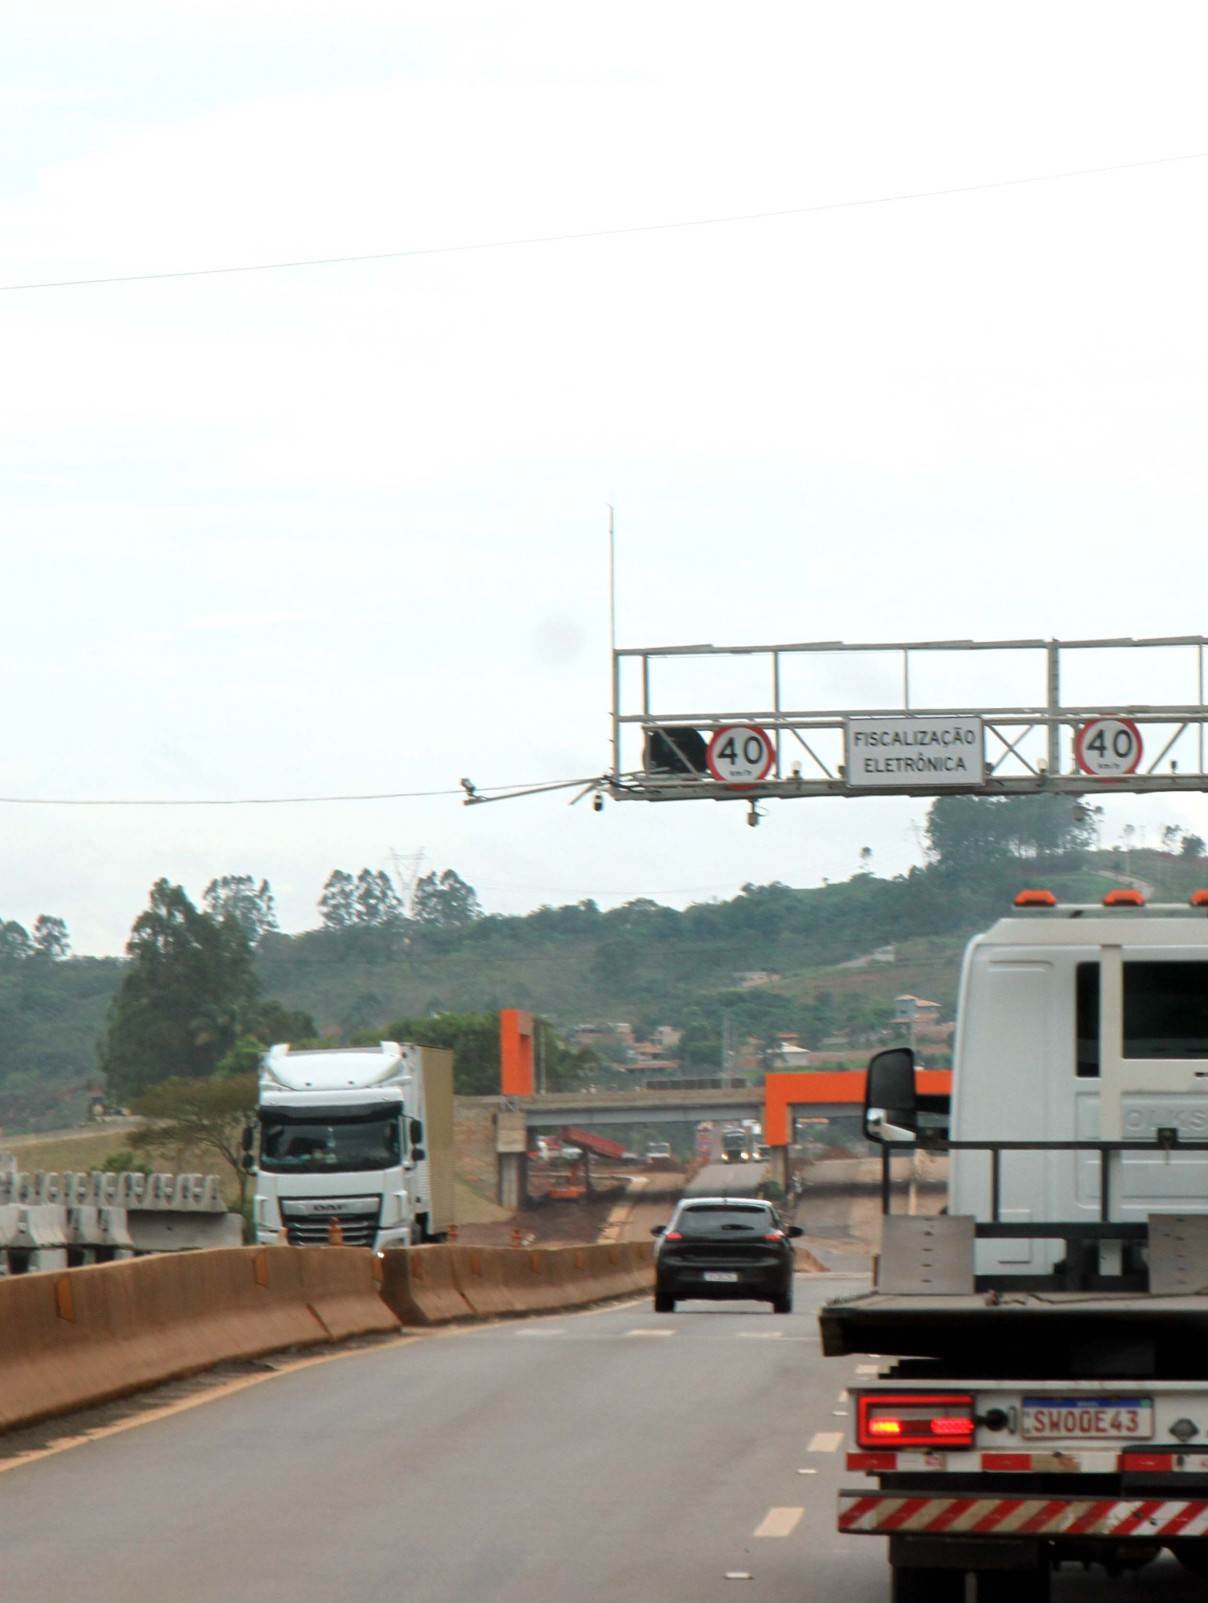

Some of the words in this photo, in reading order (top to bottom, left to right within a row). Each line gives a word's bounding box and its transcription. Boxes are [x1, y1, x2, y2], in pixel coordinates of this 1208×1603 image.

[854, 727, 976, 748] FISCALIZAÇÃO
[1086, 729, 1132, 758] 40
[717, 736, 764, 765] 40
[864, 752, 967, 773] ELETRÔNICA
